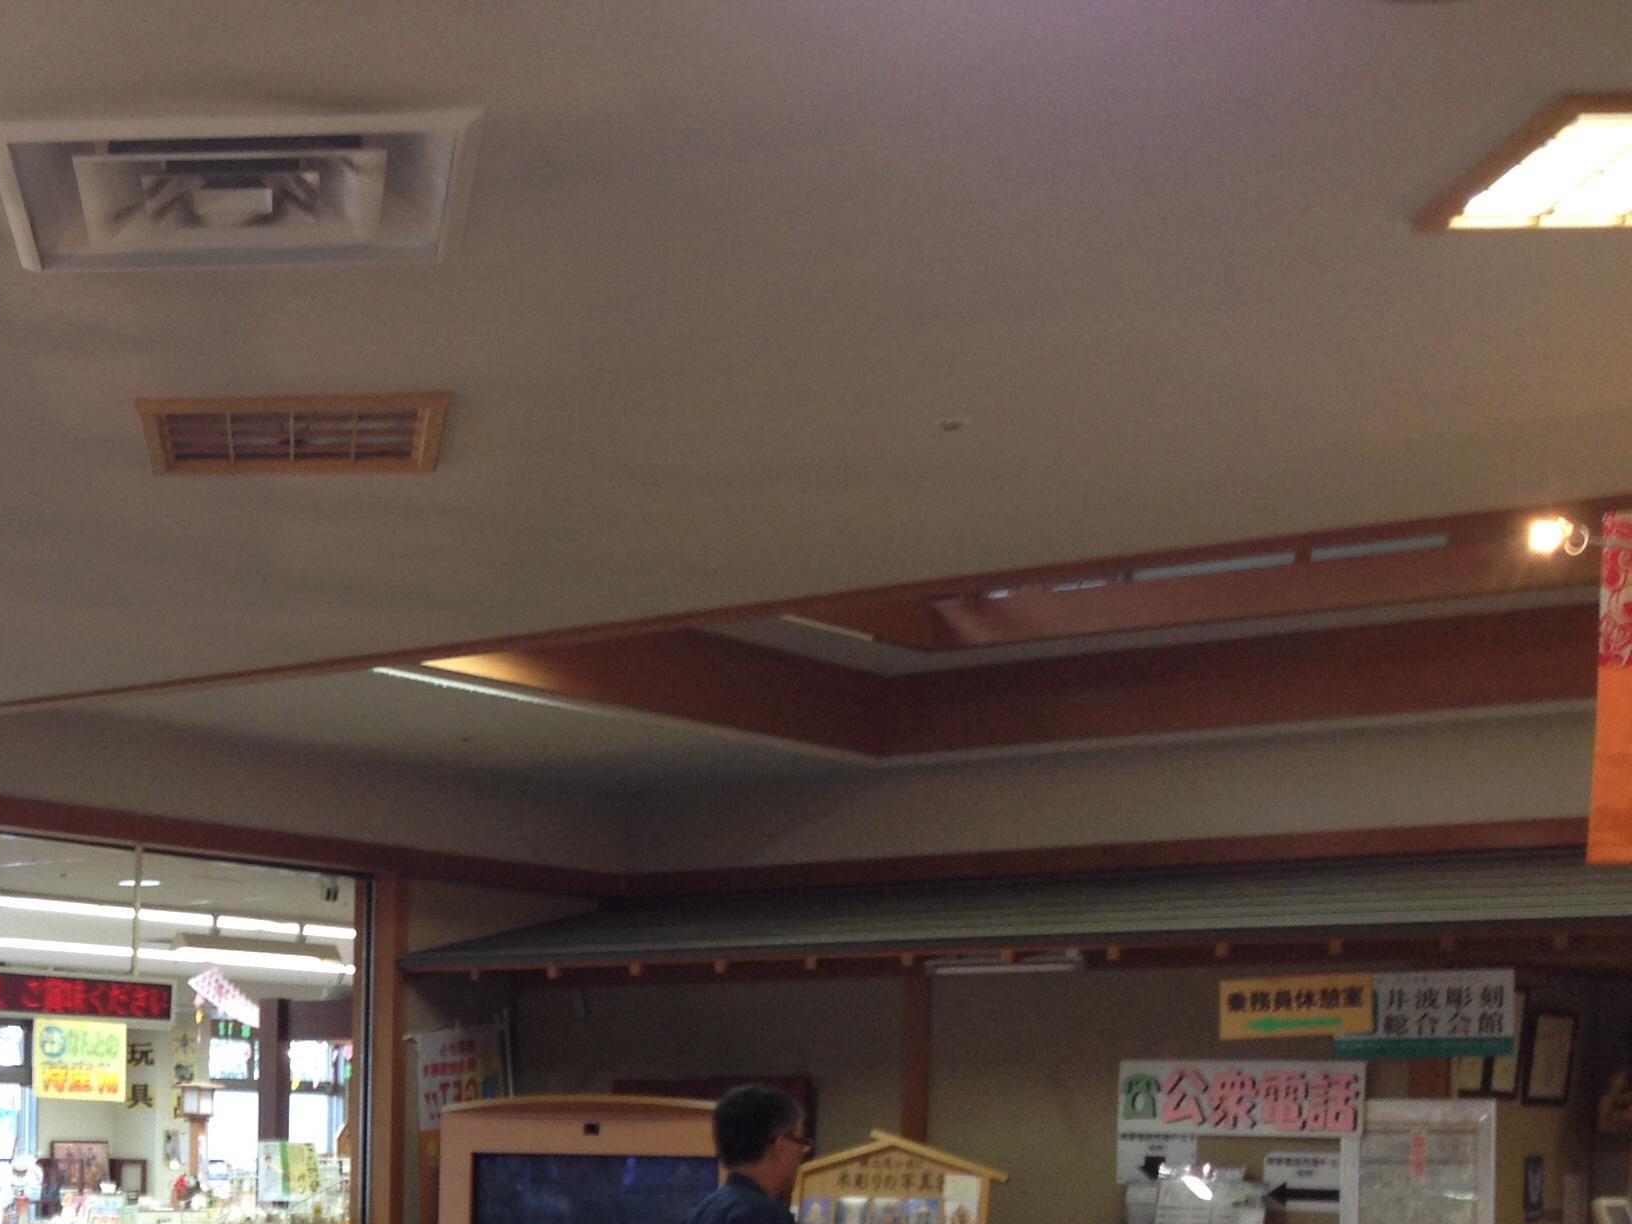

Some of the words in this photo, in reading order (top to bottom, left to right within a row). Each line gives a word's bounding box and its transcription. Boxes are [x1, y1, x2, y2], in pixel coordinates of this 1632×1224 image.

[1226, 986, 1365, 1013] 乗務員休憩室
[1386, 984, 1506, 1010] 井波彫刻
[1161, 1067, 1359, 1132] 公衆電話
